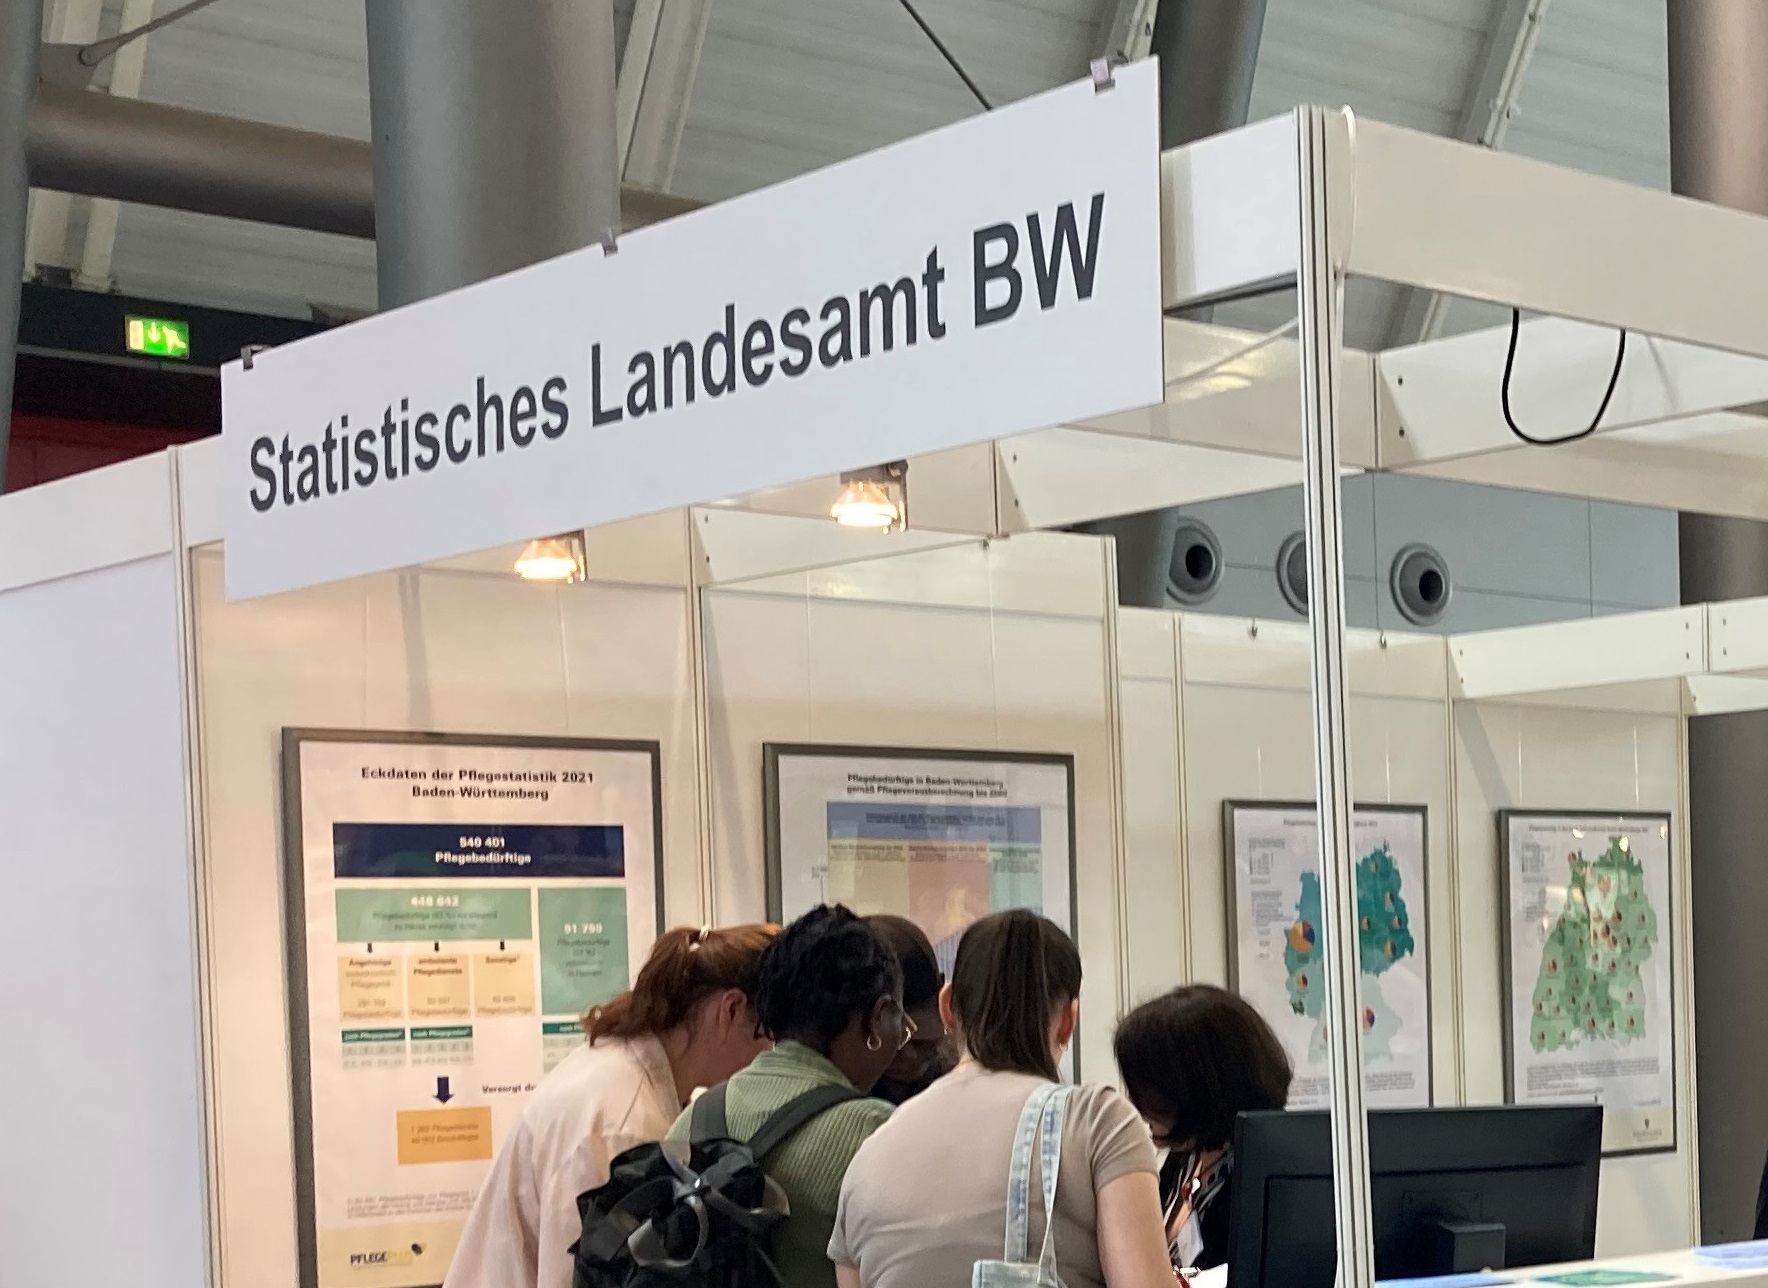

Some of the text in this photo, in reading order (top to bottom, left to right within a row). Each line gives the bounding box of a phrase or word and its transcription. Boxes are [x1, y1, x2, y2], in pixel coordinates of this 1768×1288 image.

[248, 192, 1107, 514] Statistisches Landesamt BW
[361, 767, 593, 784] Eckdaten der Pflegestatistik 2021
[412, 785, 549, 801] Baden-Württemberg
